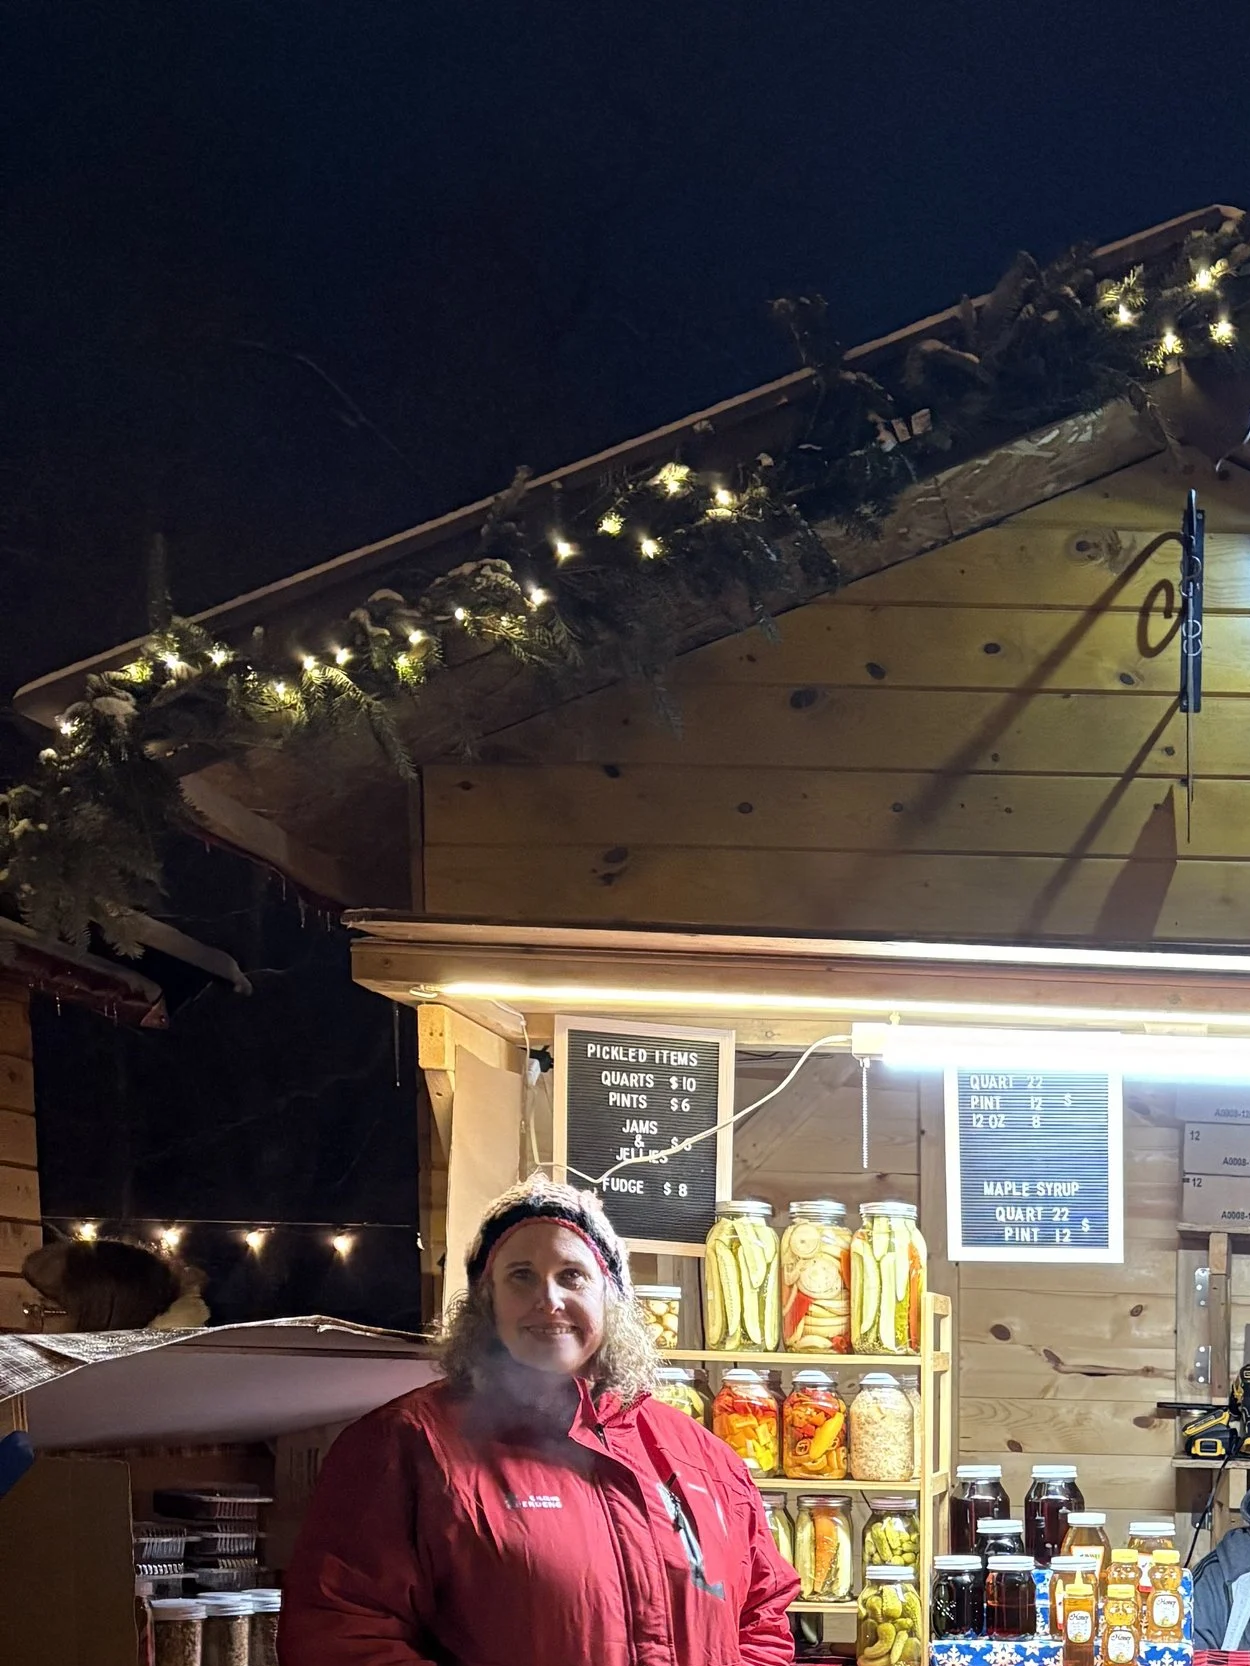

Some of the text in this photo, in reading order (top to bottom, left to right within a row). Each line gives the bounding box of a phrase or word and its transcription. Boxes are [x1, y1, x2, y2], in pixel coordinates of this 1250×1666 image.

[587, 1043, 698, 1067] PICKLED ITEMS
[601, 1071, 655, 1088] QUARTS
[969, 1074, 1044, 1090] QUART 22
[608, 1092, 647, 1109] PINTS
[970, 1095, 1043, 1111] PINT 12
[622, 1119, 658, 1134] JAMS
[972, 1113, 1041, 1128] 12 OZ 8
[634, 1134, 645, 1148] &
[1189, 1131, 1200, 1141] 12
[602, 1177, 644, 1194] FUDGE
[983, 1182, 1080, 1196] MAPLE SYRUP
[1191, 1177, 1203, 1188] 12
[995, 1206, 1070, 1222] QUART 22
[1004, 1227, 1071, 1242] PINT 12
[1069, 1613, 1089, 1624] Honey
